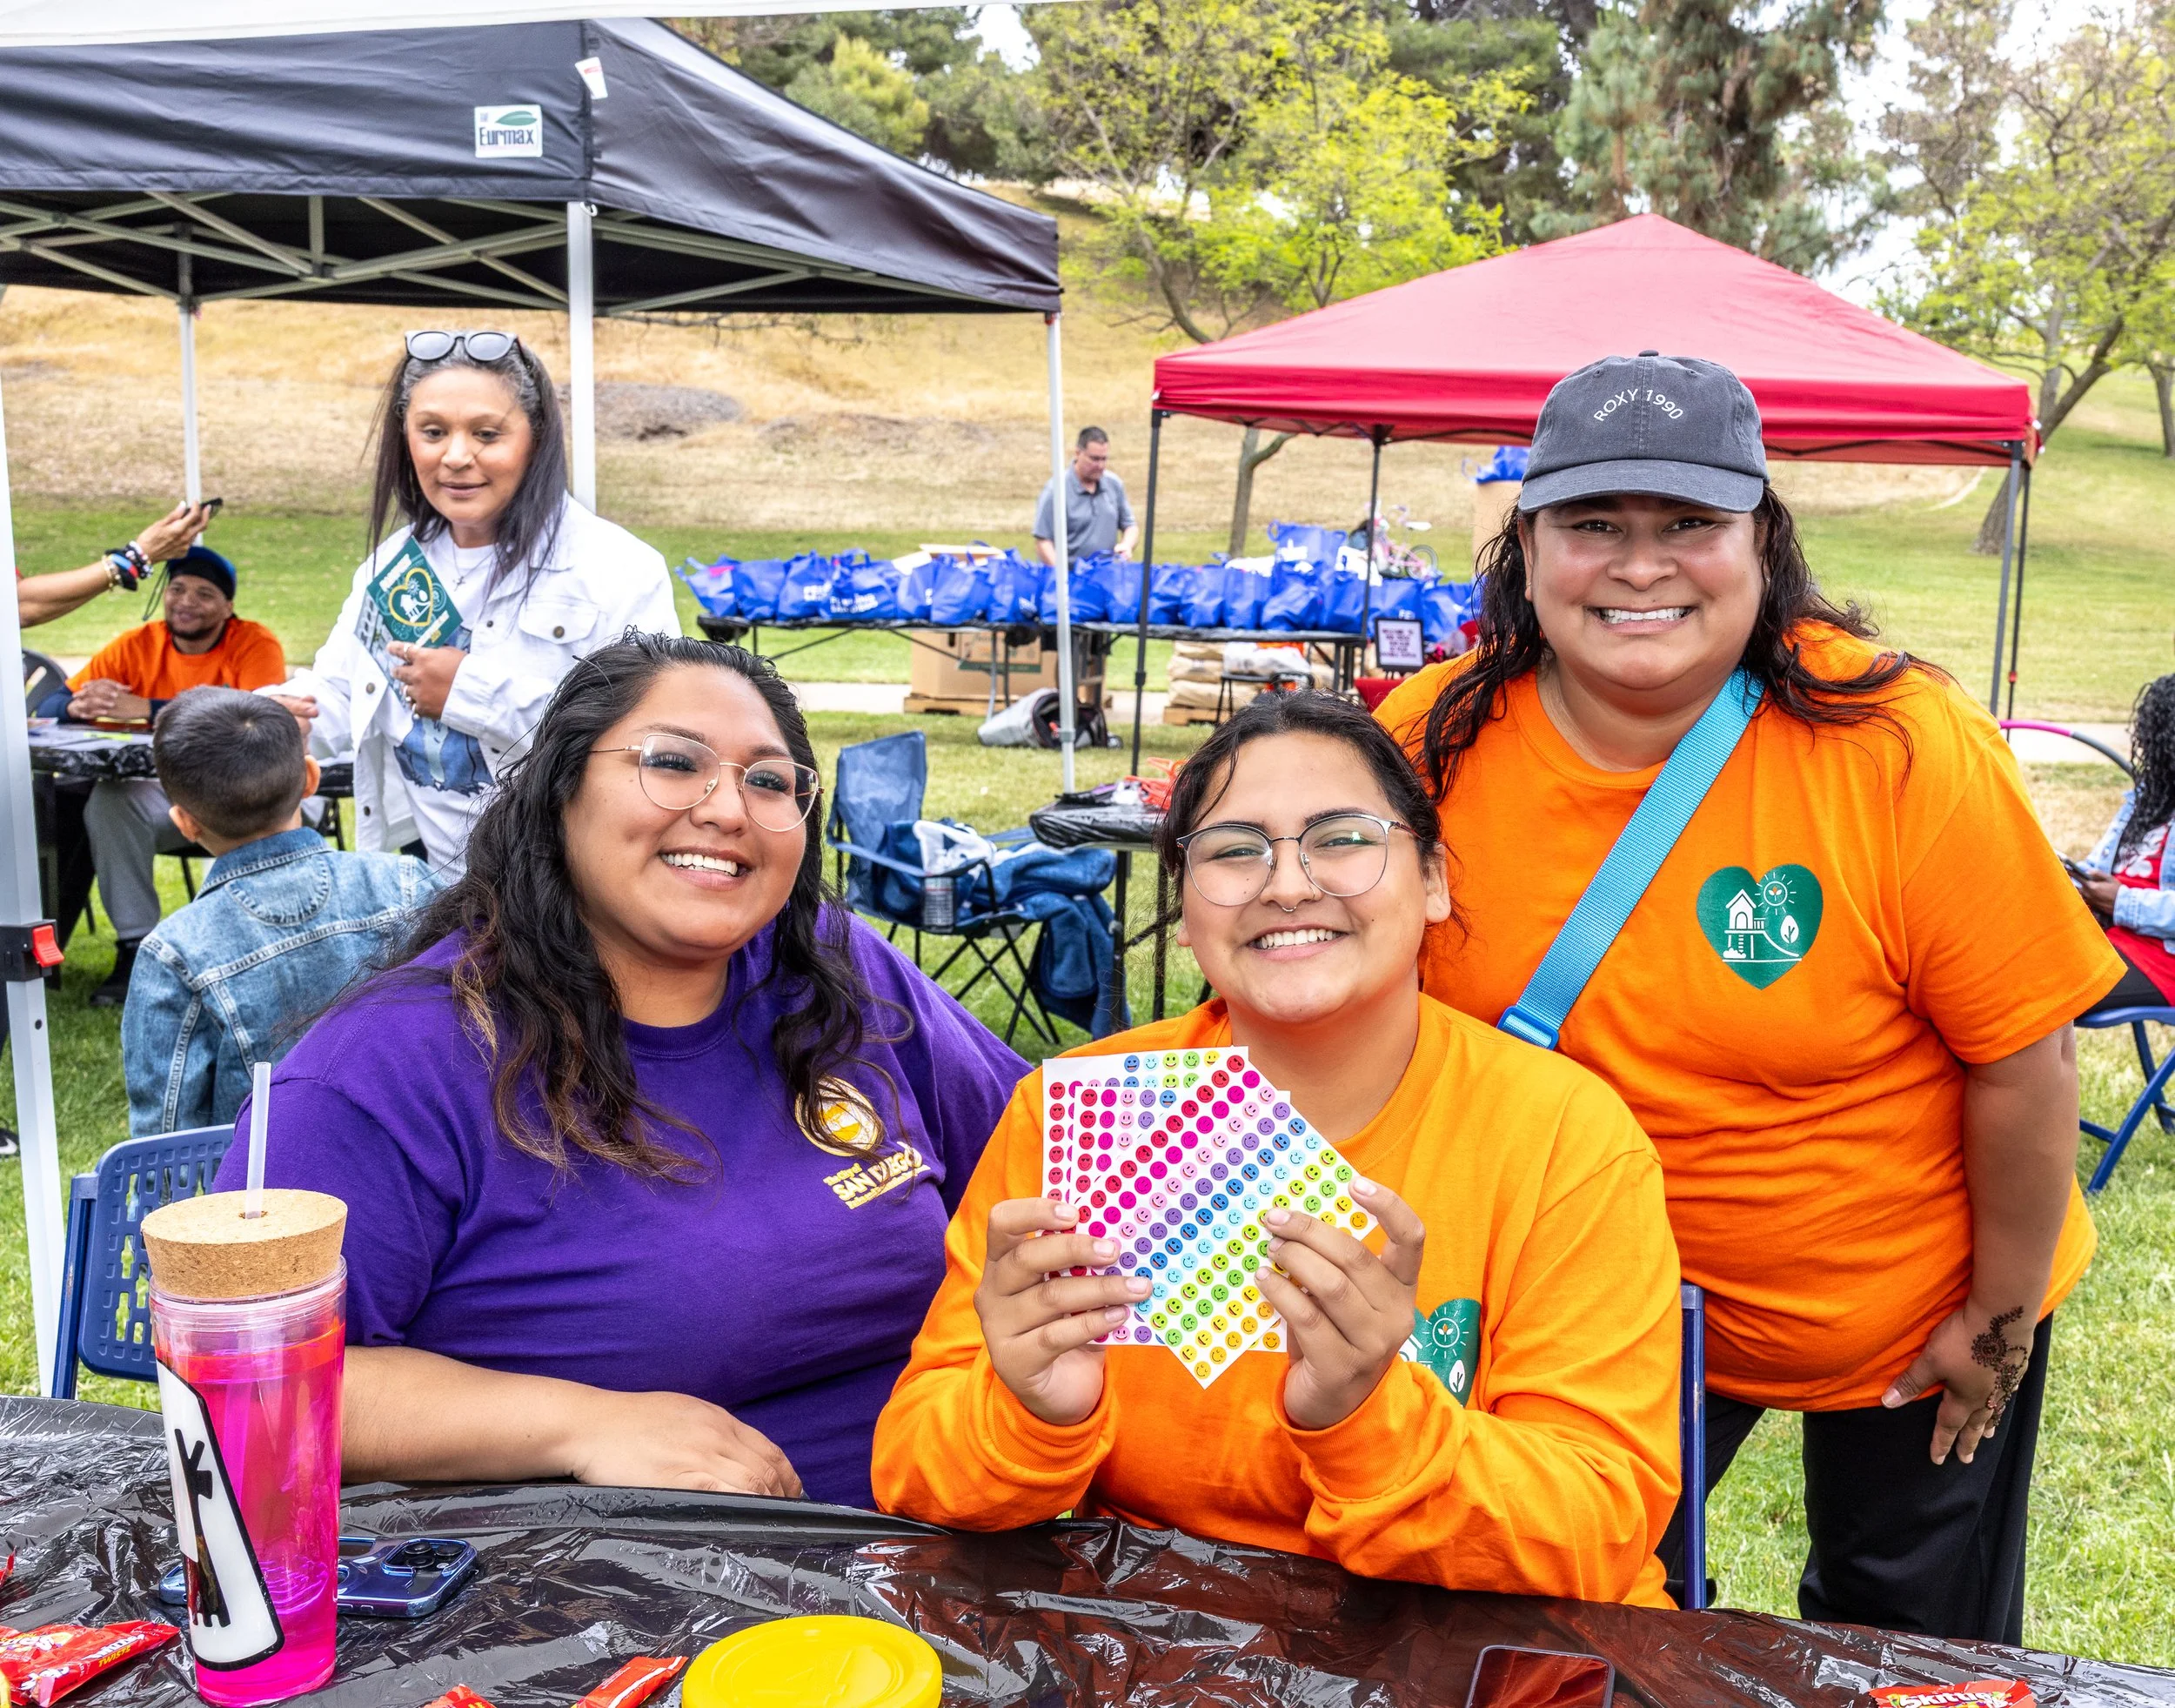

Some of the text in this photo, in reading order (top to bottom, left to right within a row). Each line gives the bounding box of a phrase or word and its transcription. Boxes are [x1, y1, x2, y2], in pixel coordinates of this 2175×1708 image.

[479, 126, 534, 146] Eurmax
[1593, 388, 1684, 422] ROXY 1990
[833, 1171, 877, 1202] SAN
[867, 1142, 923, 1183] DIEGO
[97, 1646, 131, 1668] TWISTS
